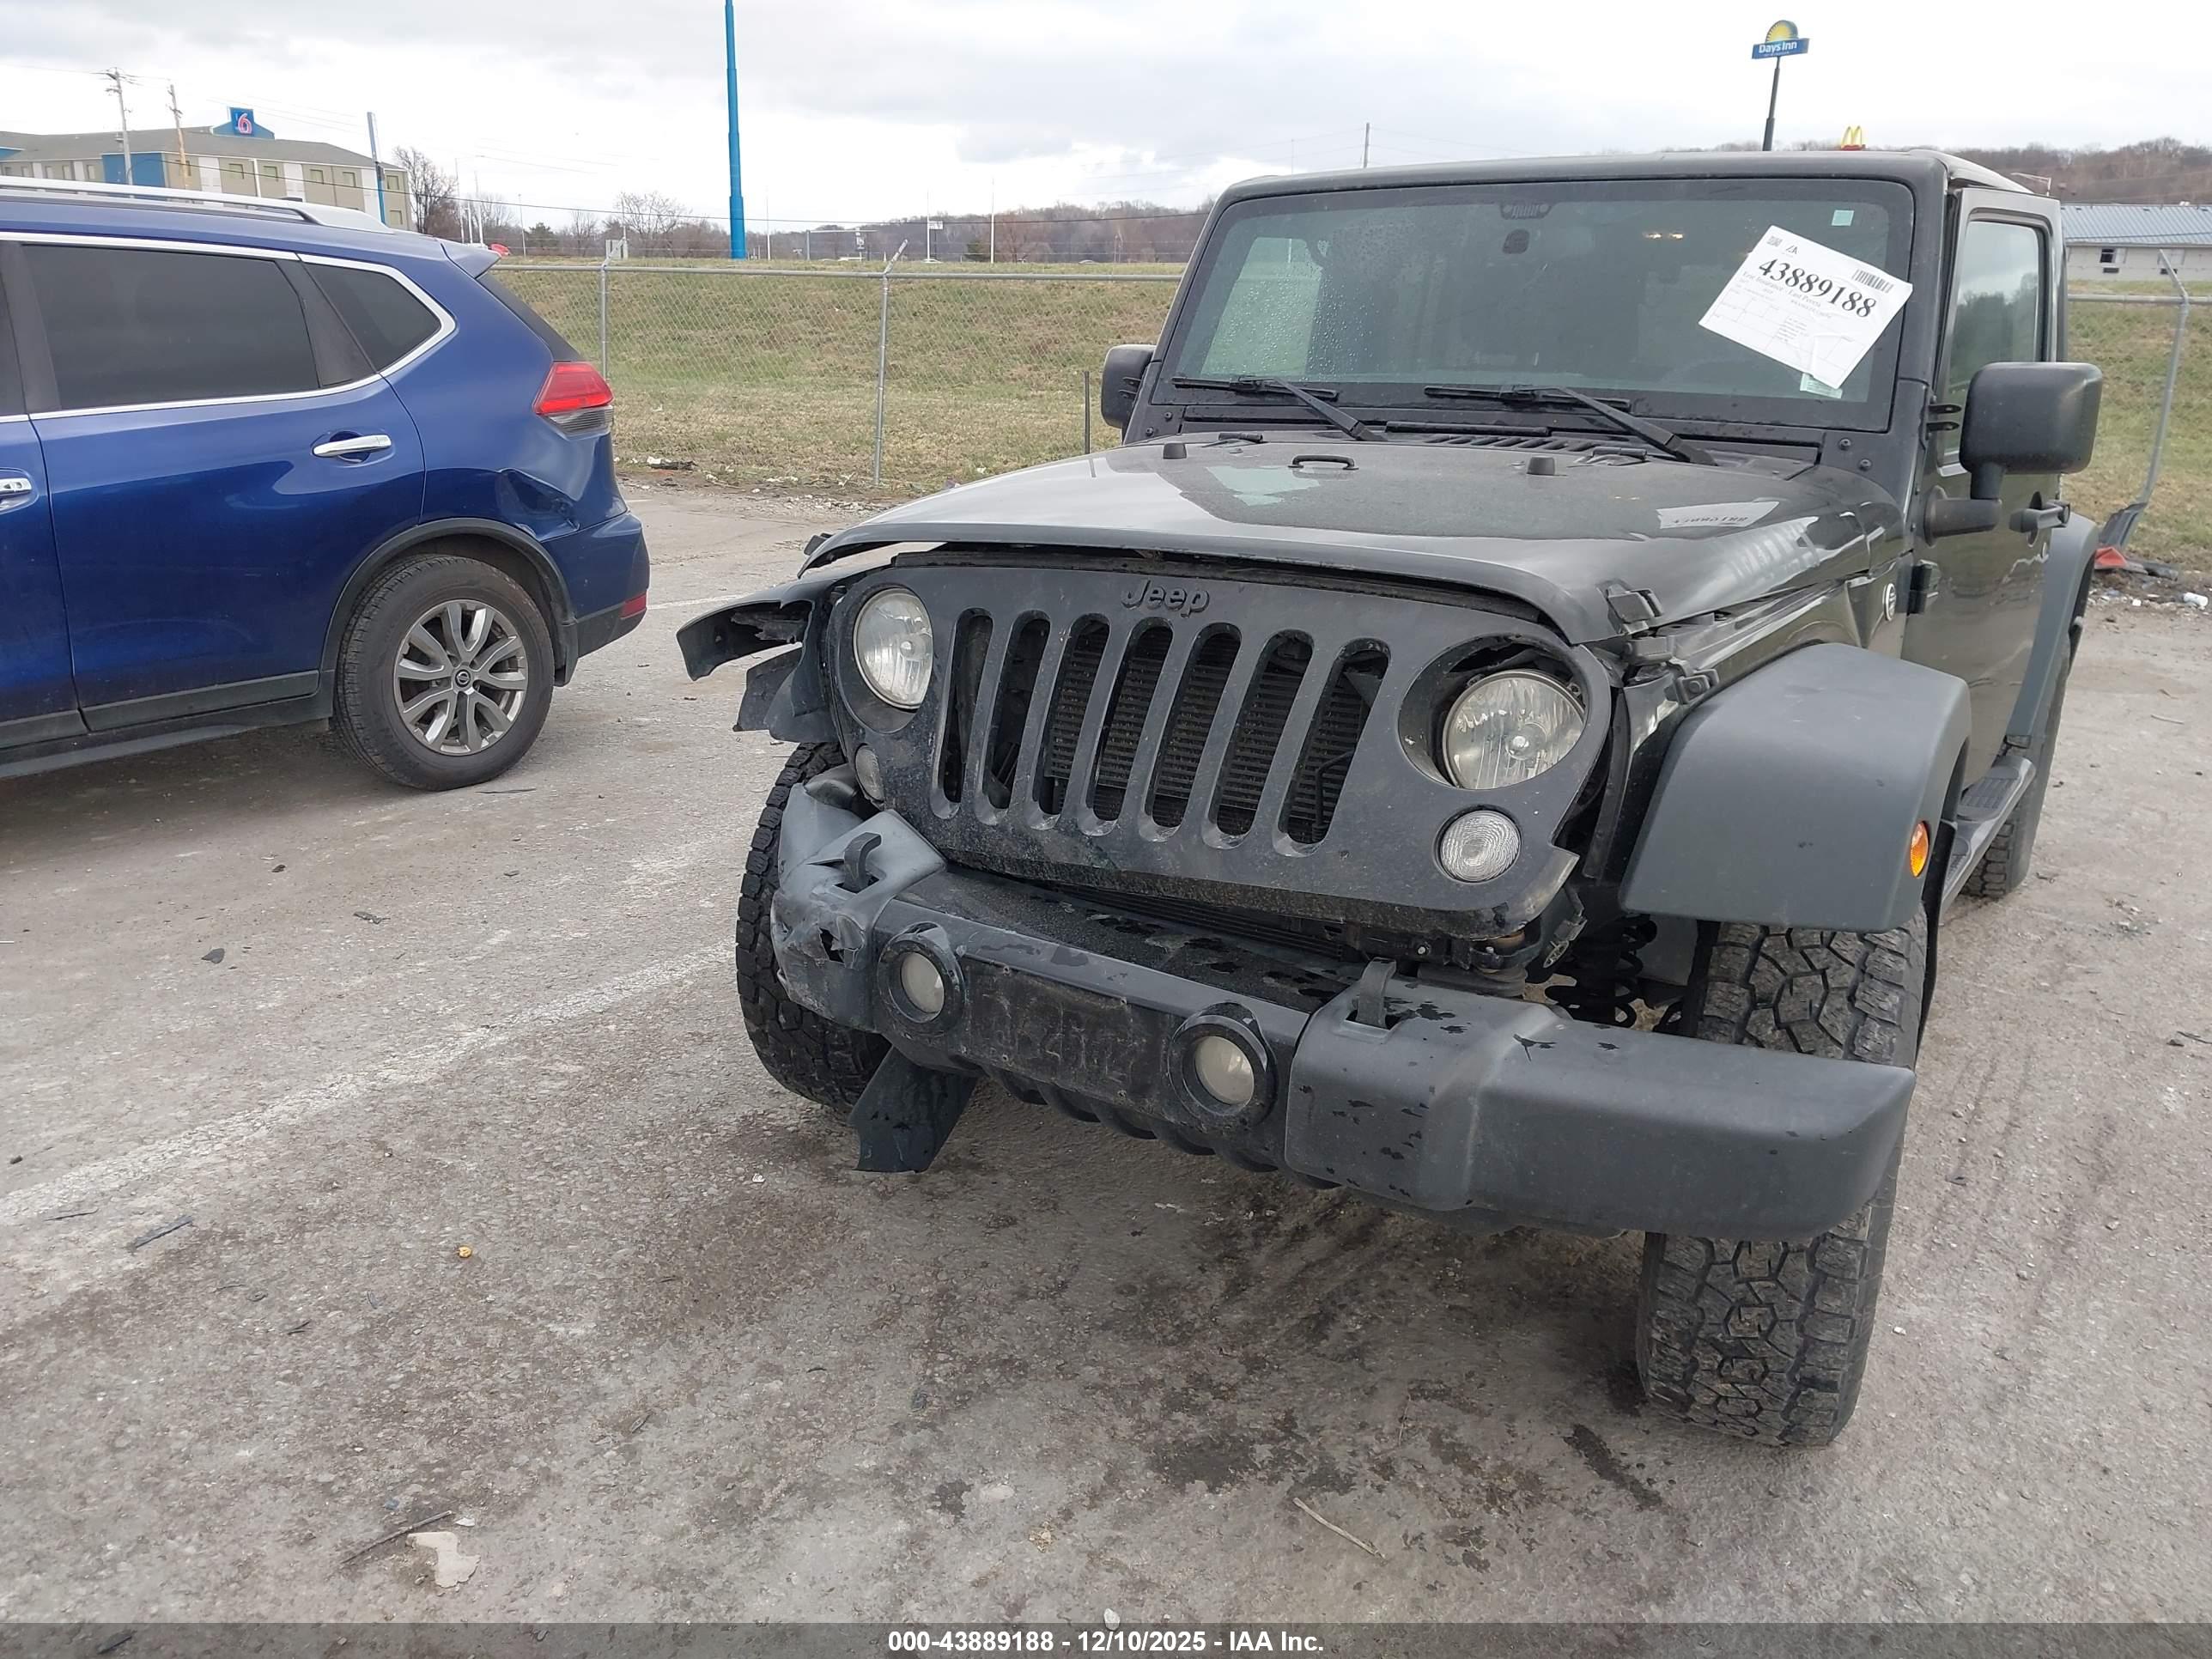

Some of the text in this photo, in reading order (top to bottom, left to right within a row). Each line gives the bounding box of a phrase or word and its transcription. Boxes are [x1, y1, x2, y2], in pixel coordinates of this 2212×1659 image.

[1759, 41, 1797, 53] Days Inn
[238, 112, 252, 134] 6
[1759, 258, 1877, 317] 43889188
[1121, 578, 1210, 617] Jeep
